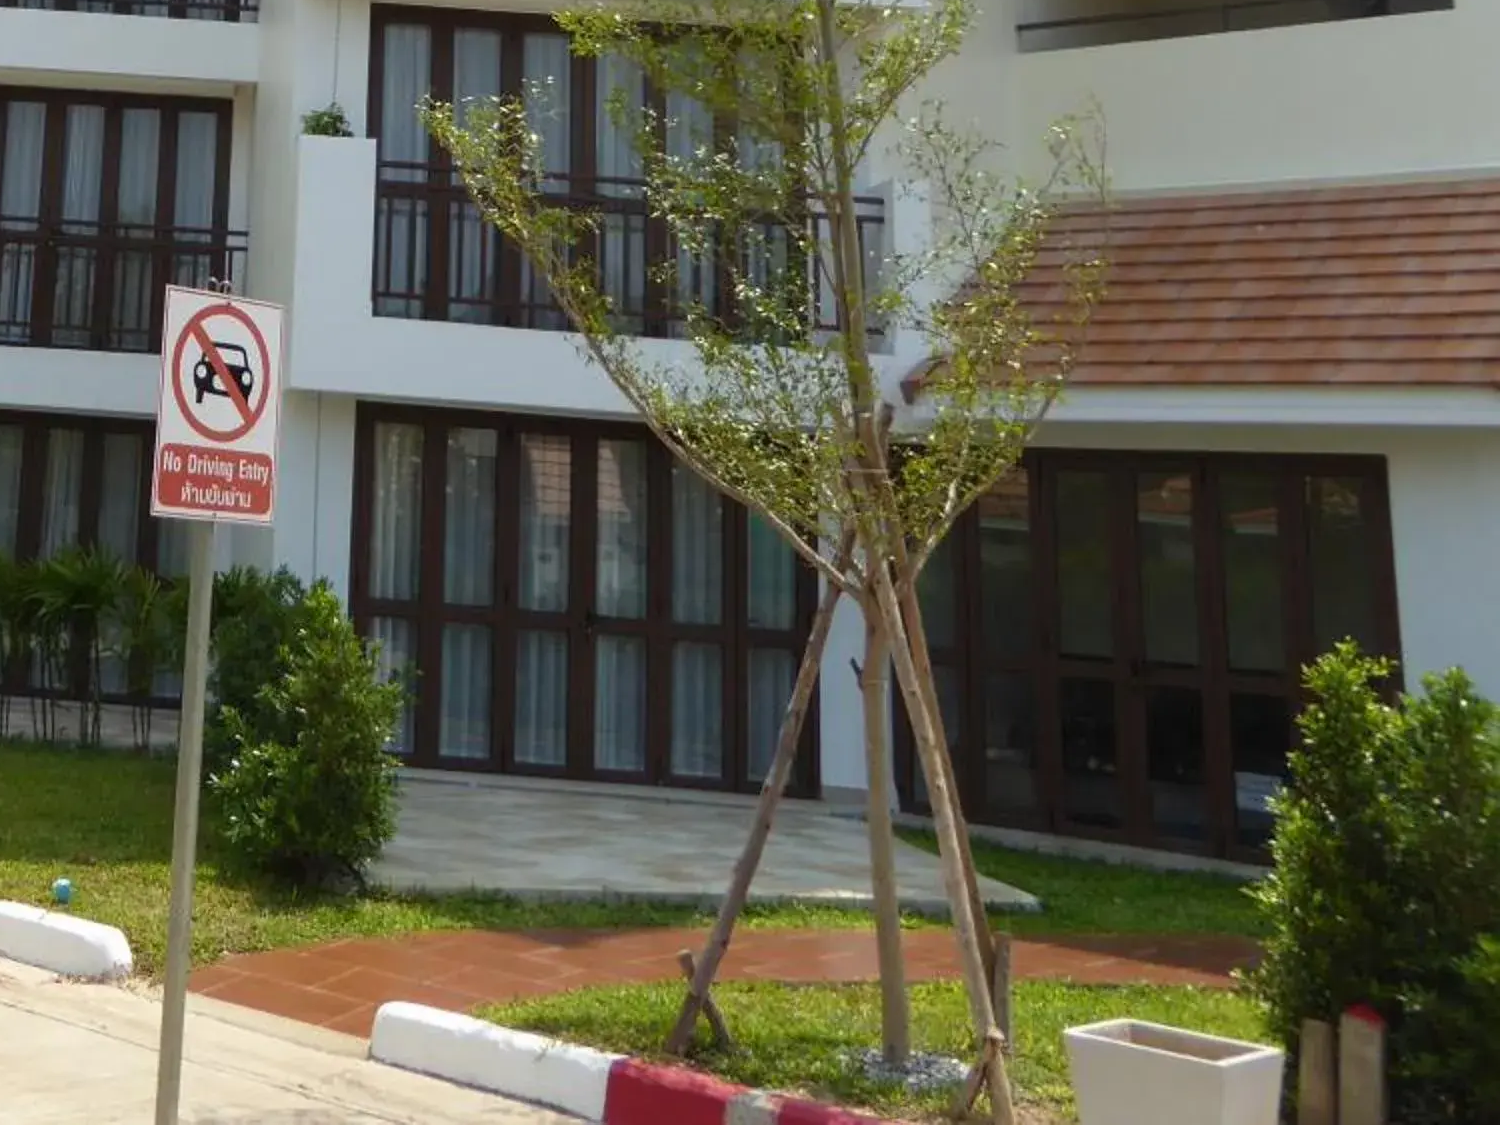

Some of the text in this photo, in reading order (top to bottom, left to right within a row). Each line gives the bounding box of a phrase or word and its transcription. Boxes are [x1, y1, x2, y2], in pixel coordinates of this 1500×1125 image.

[163, 450, 269, 487] No Driving Entry
